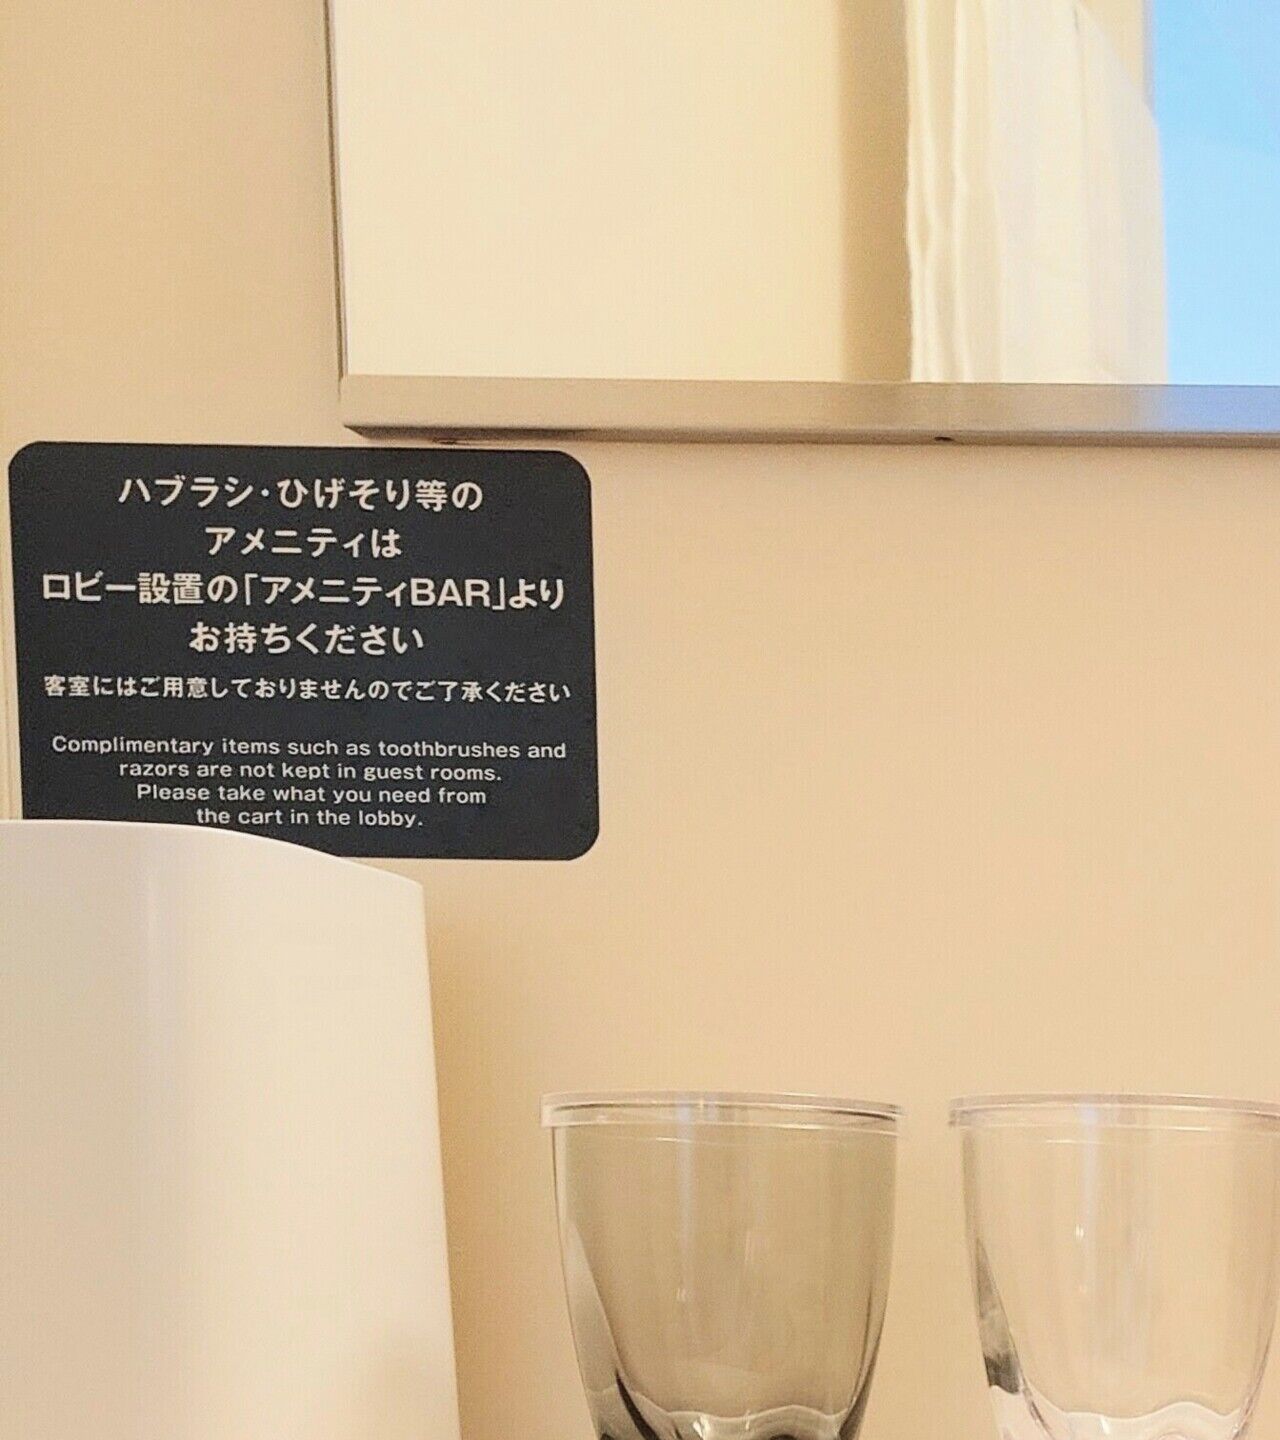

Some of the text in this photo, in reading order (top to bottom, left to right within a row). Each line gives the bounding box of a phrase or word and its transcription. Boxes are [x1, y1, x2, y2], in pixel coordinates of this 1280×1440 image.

[119, 474, 484, 512] ハブラシ・ひげそり等の
[205, 526, 402, 559] アメニティは
[42, 570, 565, 611] ロビー設置の「アメニティBAR」より
[189, 621, 425, 656] お持ちください
[43, 674, 571, 703] 客室にはご用意しておりませんのでご了承ください
[52, 734, 567, 759] Complimentary items such as toothbrushes and
[119, 762, 502, 782] razors are not kept in guest rooms.
[136, 782, 488, 805] Please take what you need from
[196, 808, 424, 829] the cart in the lobby.
